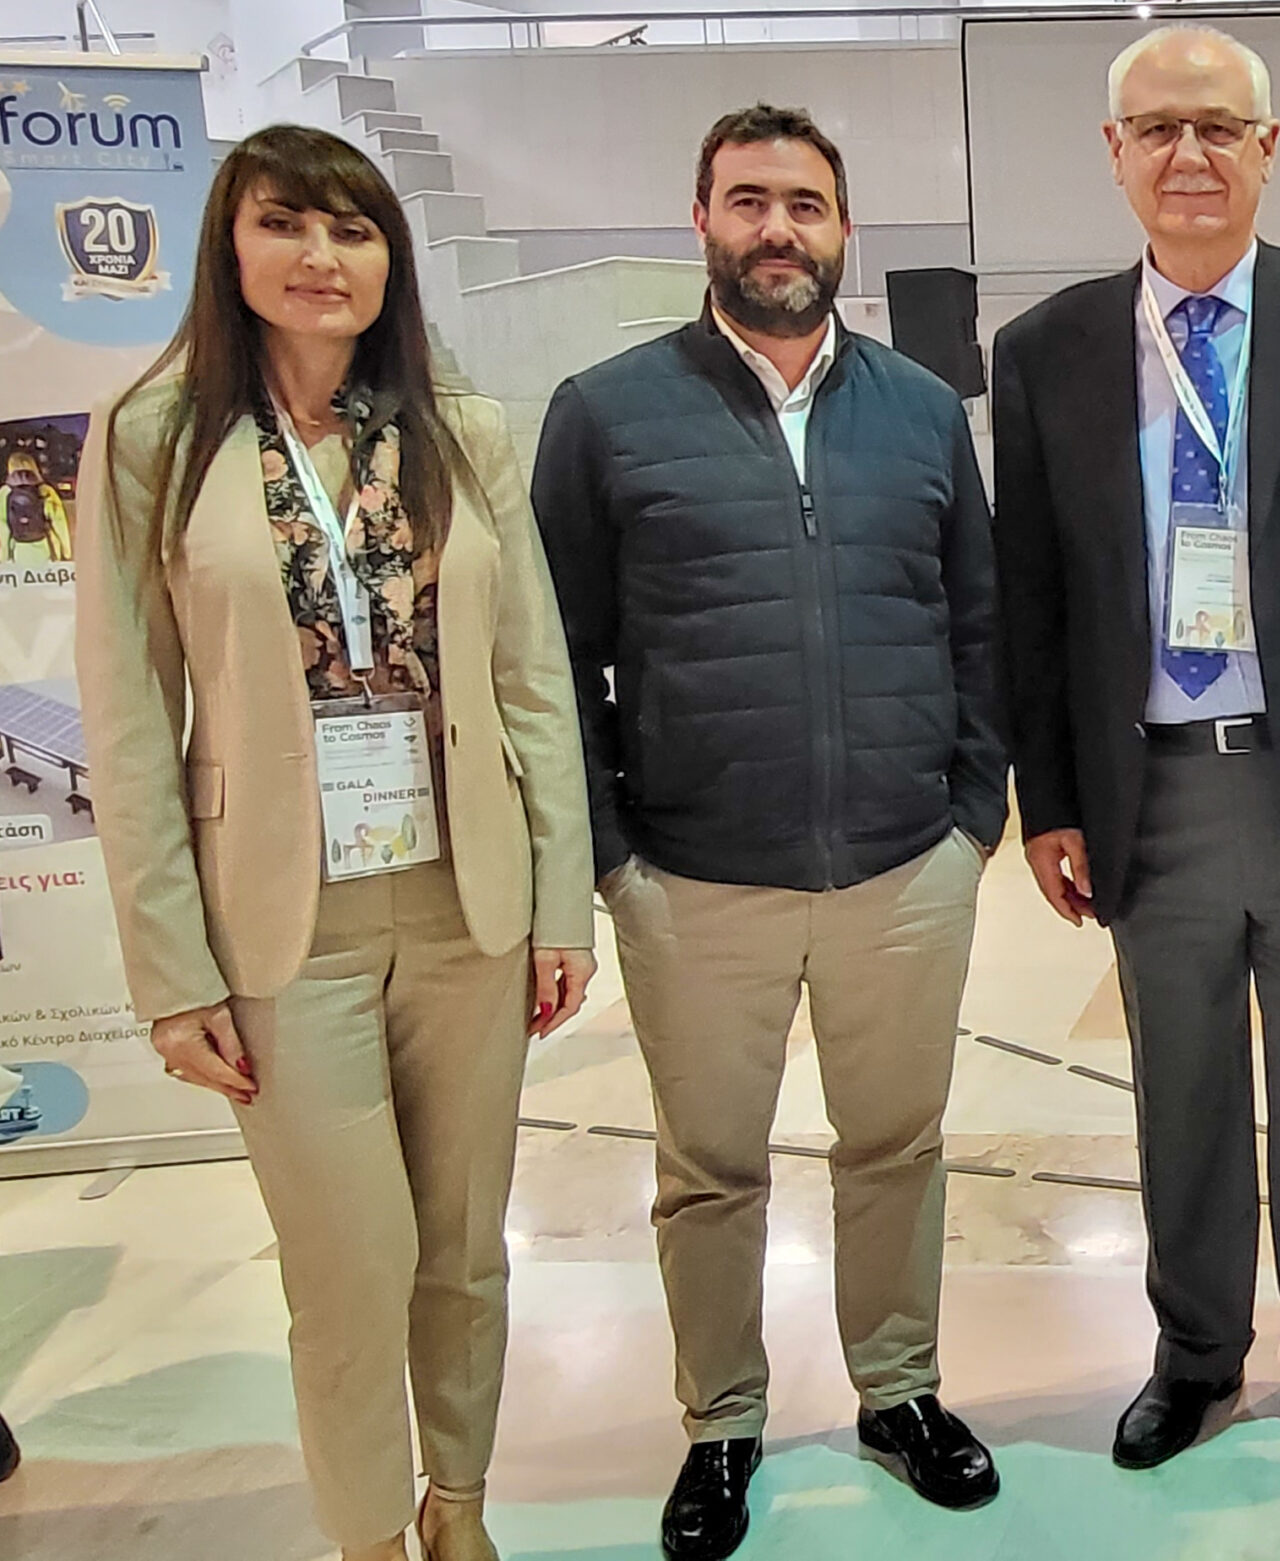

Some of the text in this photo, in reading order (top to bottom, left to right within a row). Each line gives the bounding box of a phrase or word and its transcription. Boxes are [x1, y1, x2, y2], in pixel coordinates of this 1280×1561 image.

[0, 95, 181, 148] forum
[80, 208, 136, 252] 20
[88, 254, 136, 265] ΧΡΟΝΙΑ
[98, 264, 129, 274] ΜΑΖΙ
[322, 720, 392, 733] From Chaos
[323, 731, 386, 743] to Cosmos
[336, 778, 374, 791] GALA
[363, 788, 416, 803] DINNER
[37, 871, 85, 892] για:
[35, 1008, 46, 1021] &
[50, 1004, 121, 1021] Σχολικών
[23, 1034, 75, 1047] Κέντρο
